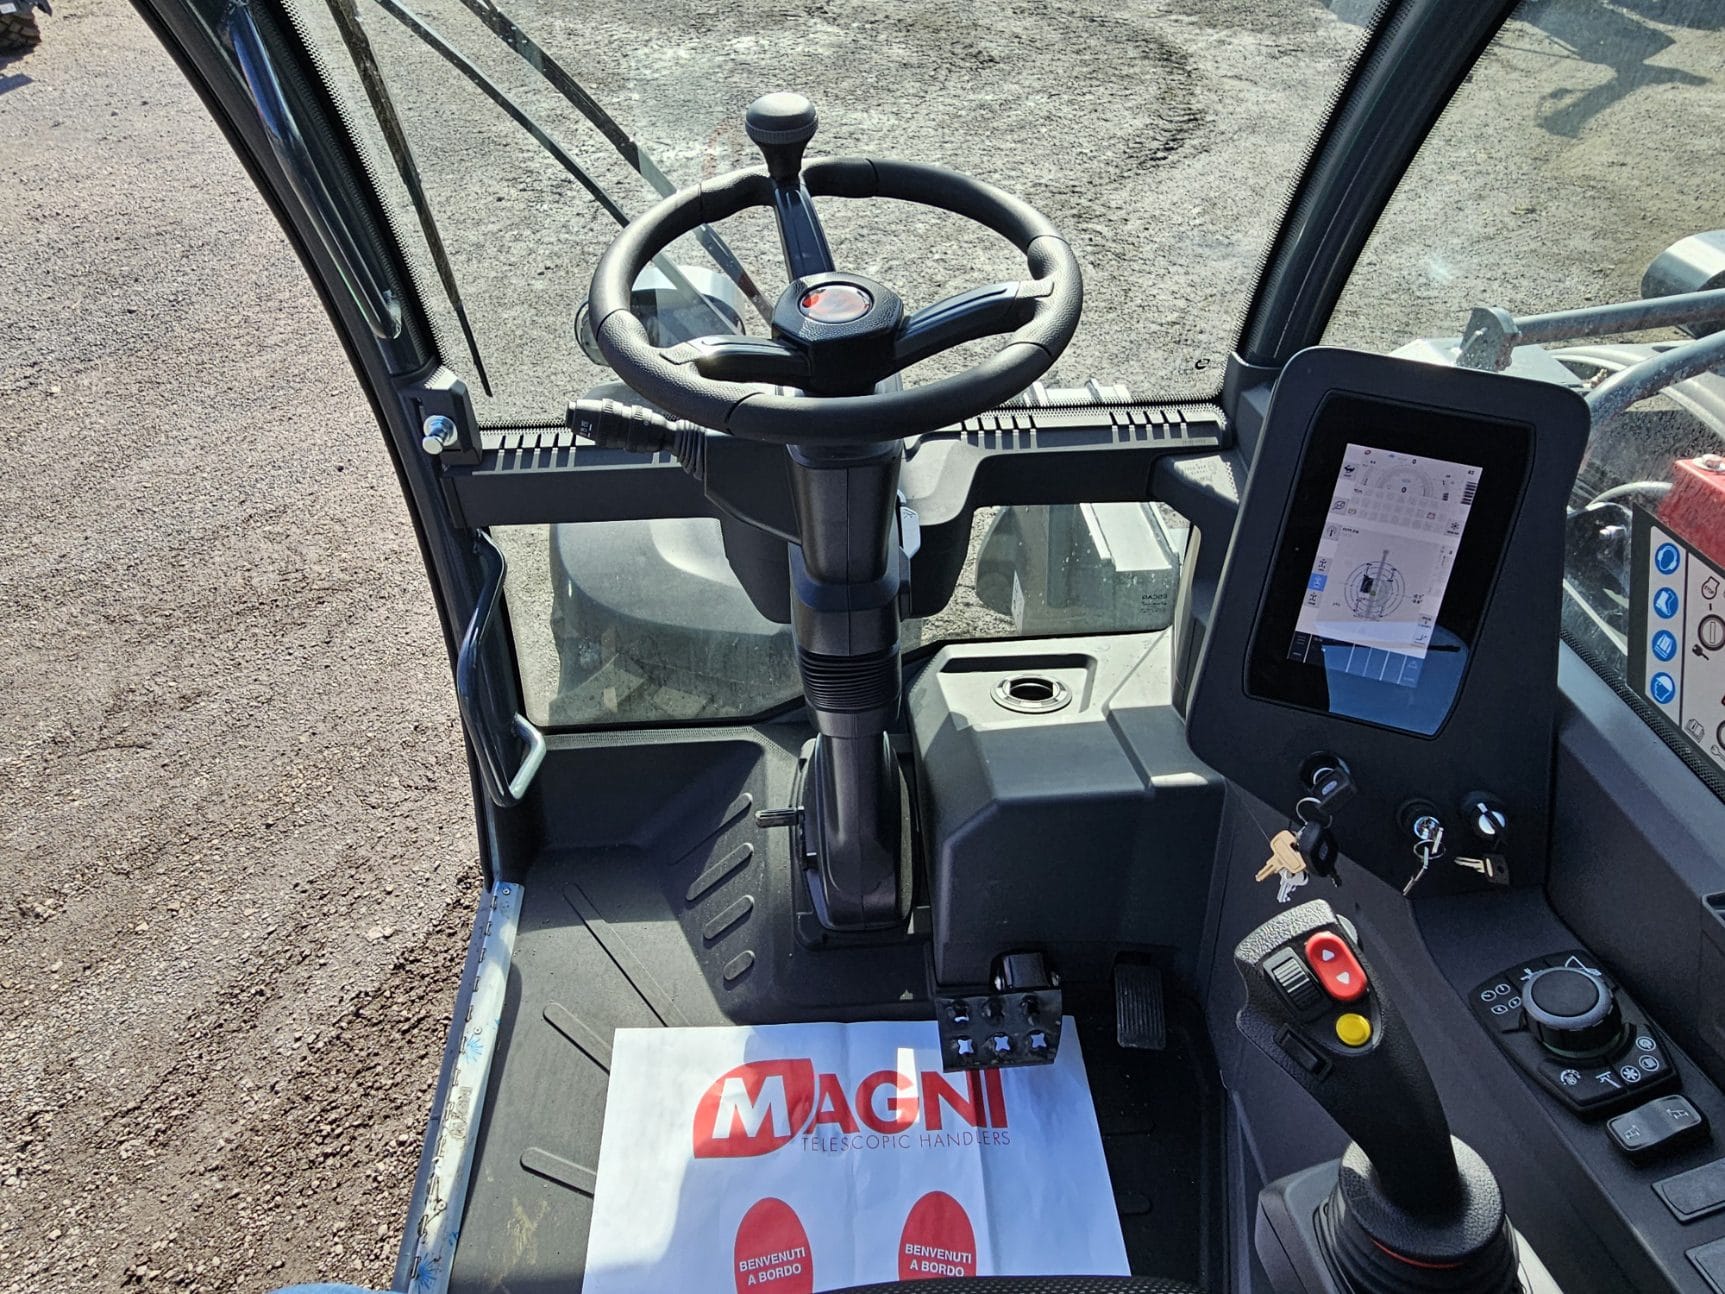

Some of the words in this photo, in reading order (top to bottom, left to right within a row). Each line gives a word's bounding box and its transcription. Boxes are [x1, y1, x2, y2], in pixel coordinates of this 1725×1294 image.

[711, 1067, 1008, 1139] MAGNI
[801, 1133, 912, 1152] TELESCOPIC
[919, 1131, 1012, 1149] HANDLERS
[739, 1246, 806, 1272] BENVENUTI
[904, 1243, 972, 1264] BENVENUTI
[747, 1273, 757, 1286] A
[758, 1262, 802, 1284] BORDO
[909, 1259, 919, 1271] A
[921, 1260, 965, 1277] BORDO
